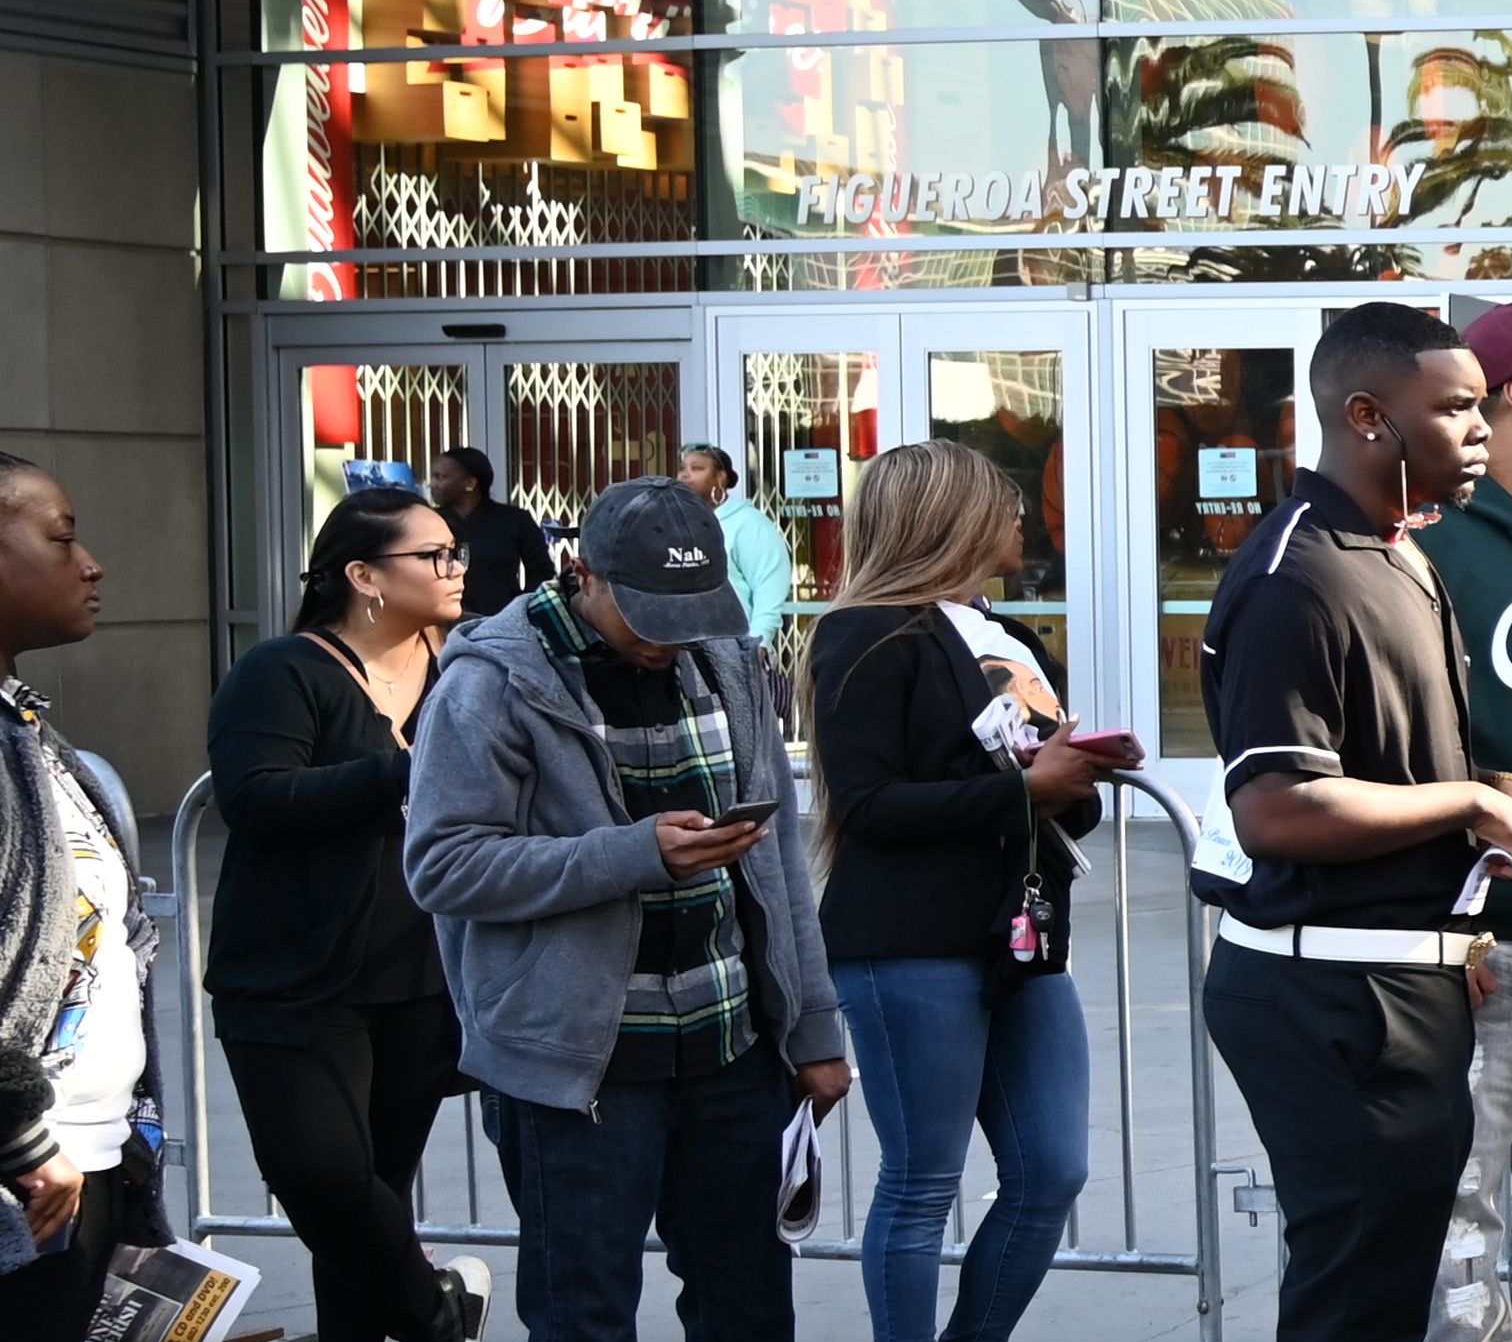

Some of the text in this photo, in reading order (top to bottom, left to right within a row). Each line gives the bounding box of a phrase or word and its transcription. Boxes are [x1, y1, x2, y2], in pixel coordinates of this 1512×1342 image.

[797, 162, 1426, 226] FIGUEROA STREET ENTRY
[668, 546, 707, 562] Nah.
[174, 1321, 188, 1337] CD
[184, 1300, 201, 1323] and
[196, 1275, 218, 1302] DVD!
